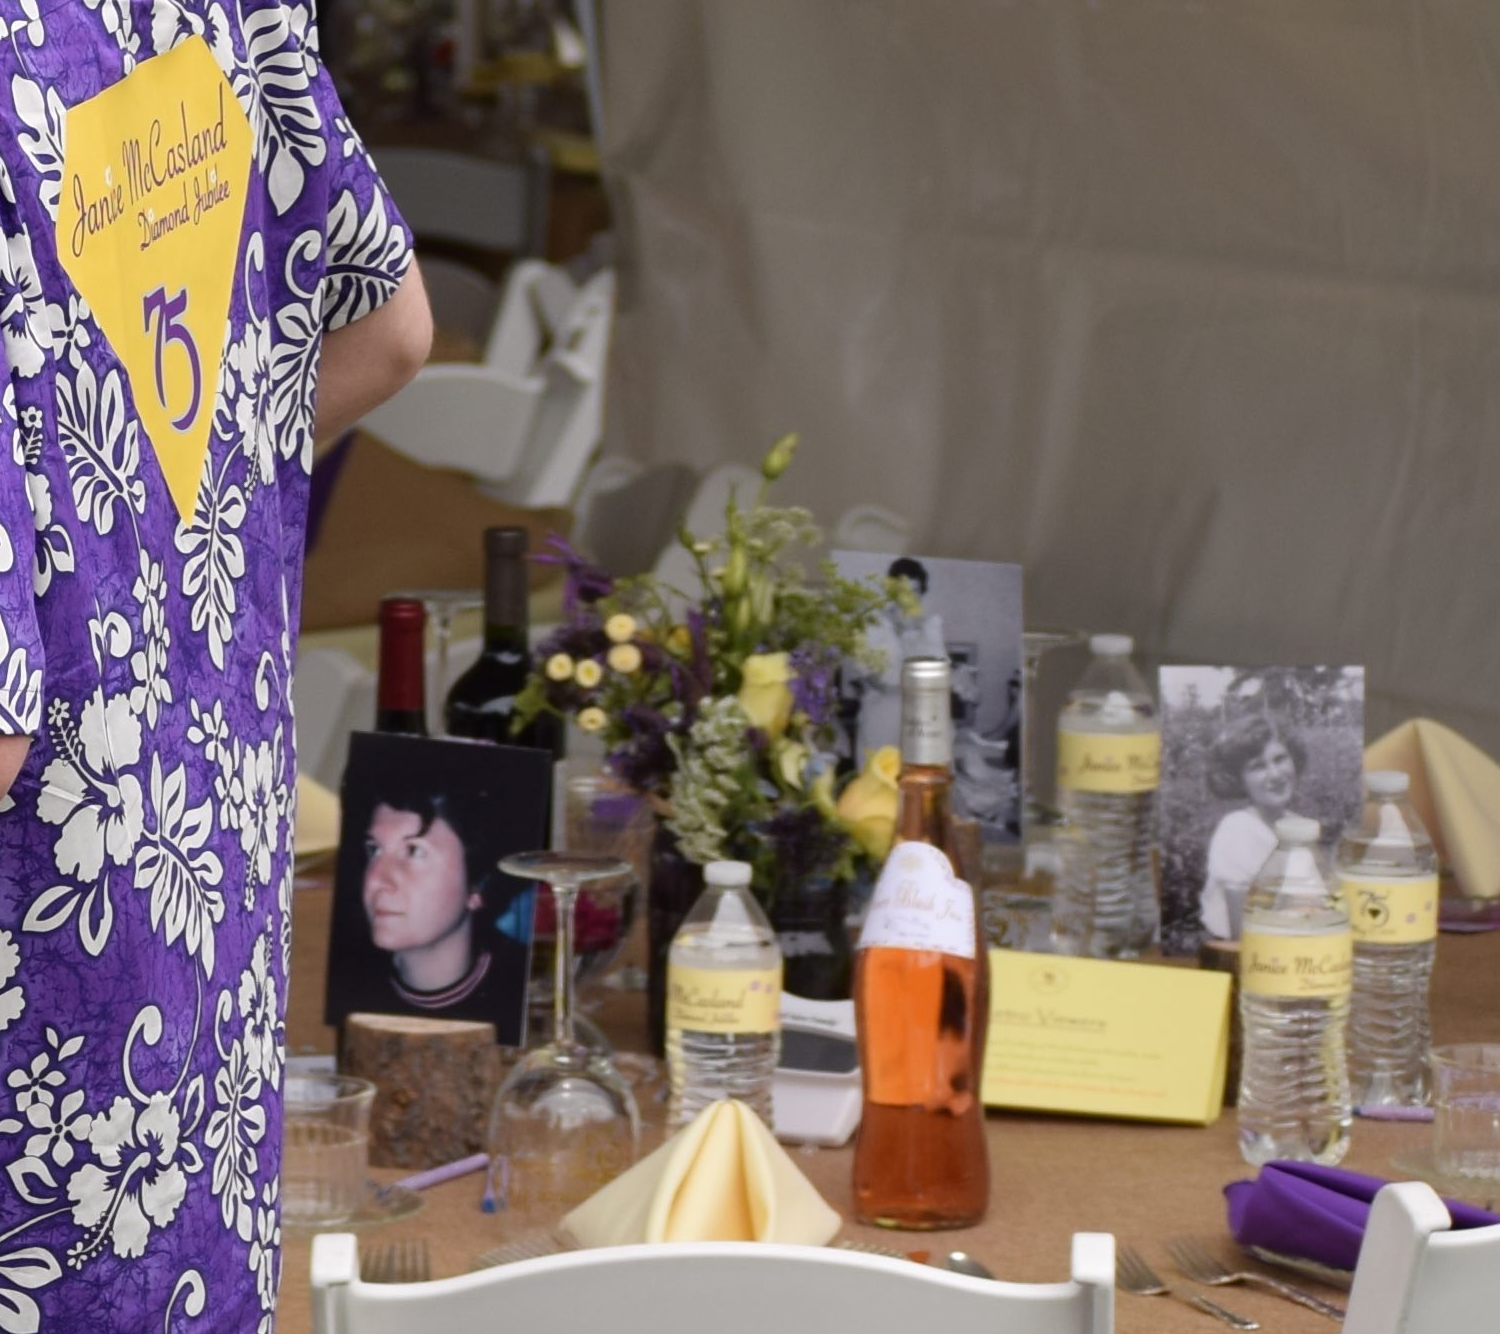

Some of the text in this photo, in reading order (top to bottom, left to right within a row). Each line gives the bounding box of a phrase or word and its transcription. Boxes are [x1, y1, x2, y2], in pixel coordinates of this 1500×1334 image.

[71, 82, 228, 258] Janice McCasland
[138, 168, 231, 252] Diamond Jubilee
[142, 284, 202, 432] 75
